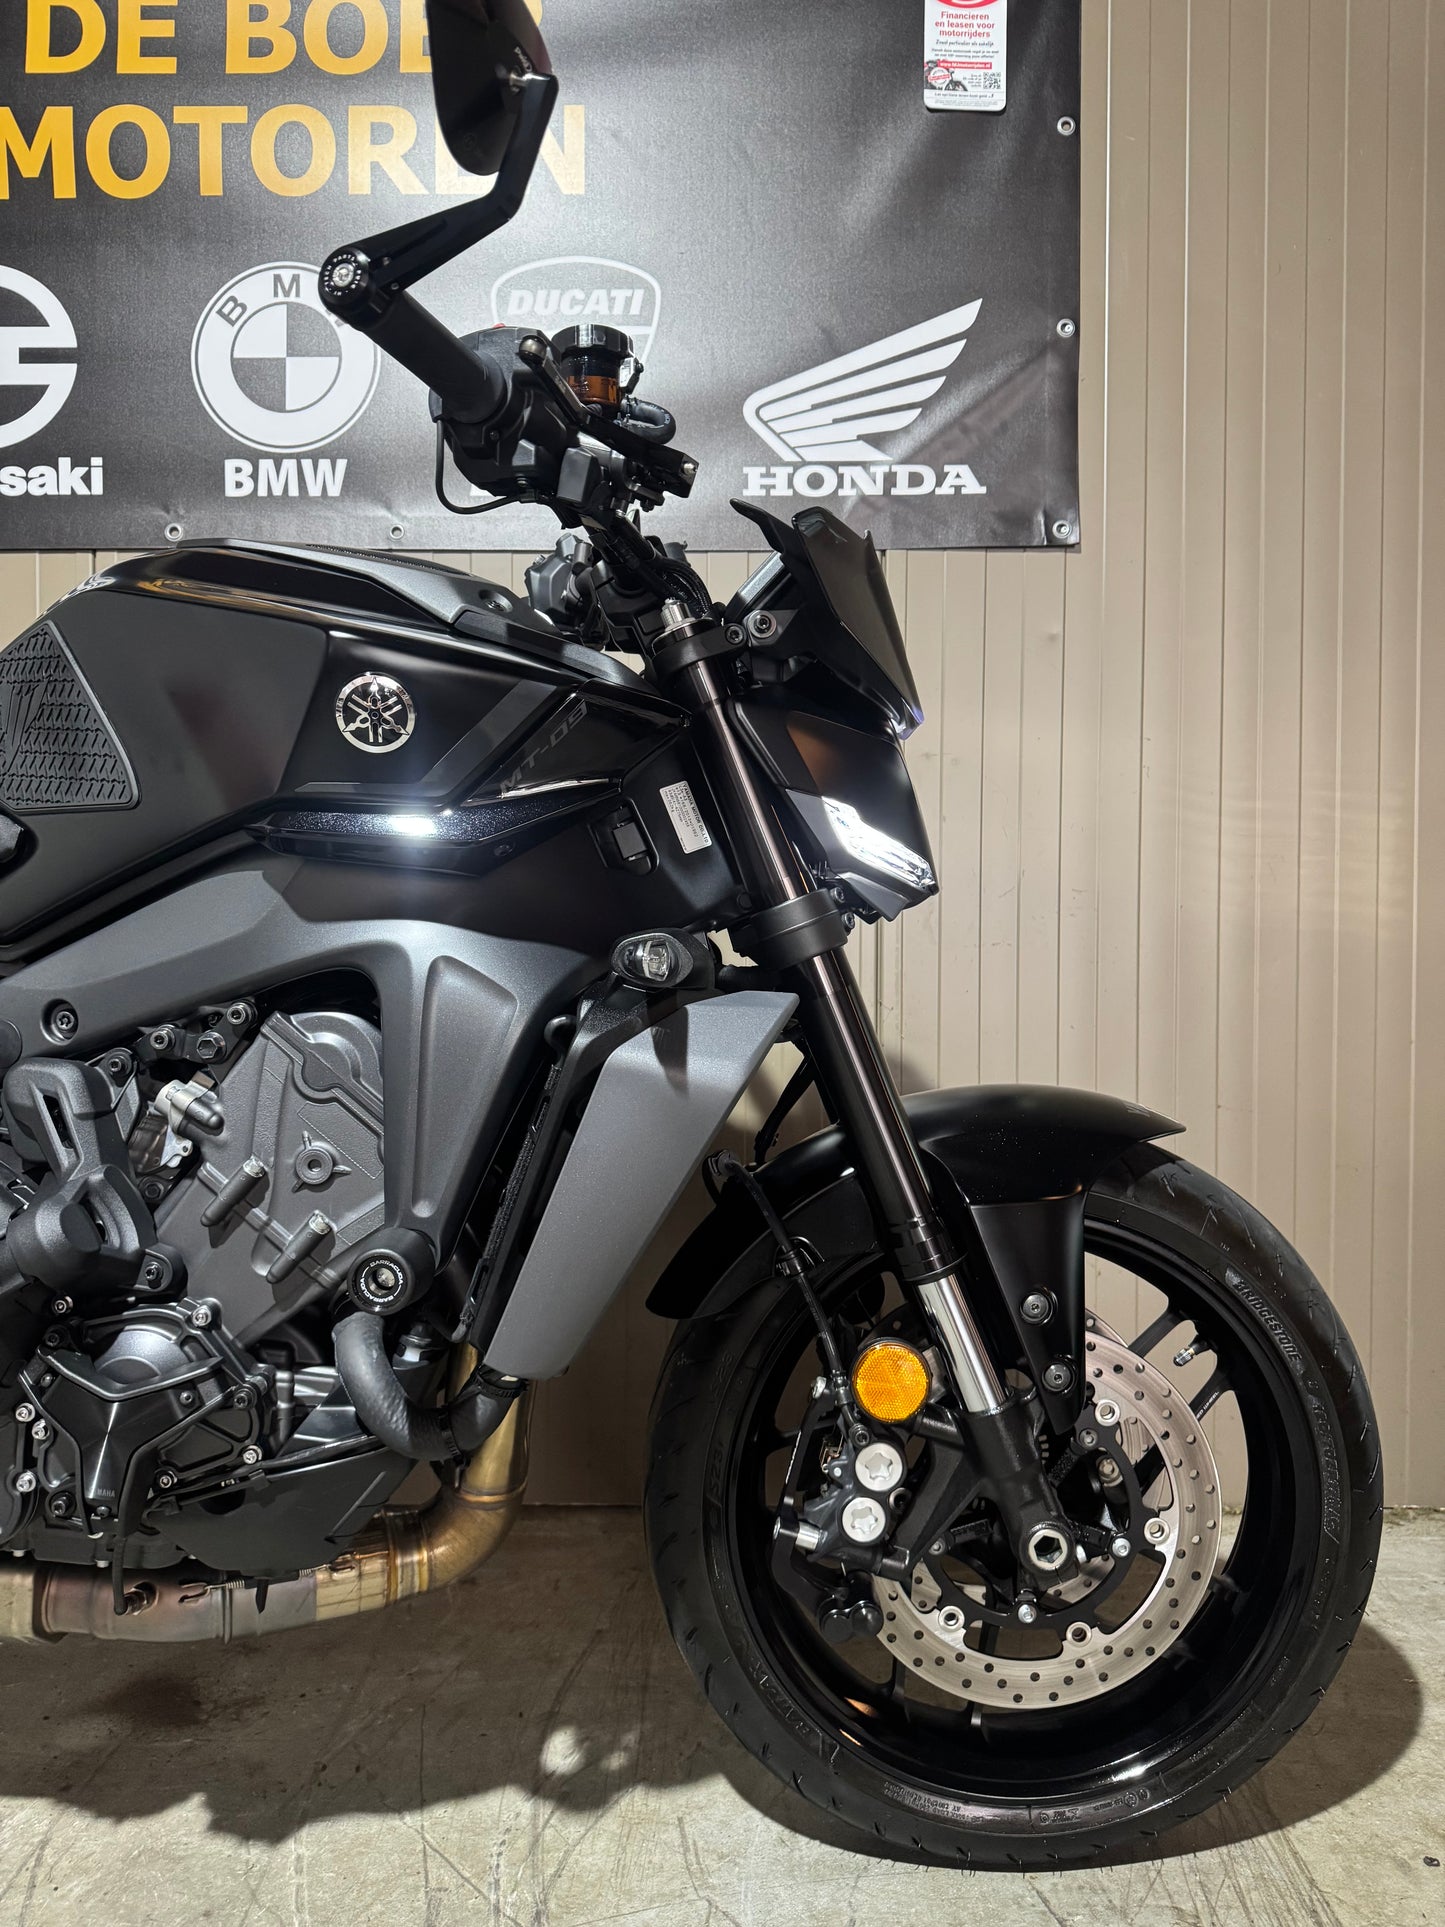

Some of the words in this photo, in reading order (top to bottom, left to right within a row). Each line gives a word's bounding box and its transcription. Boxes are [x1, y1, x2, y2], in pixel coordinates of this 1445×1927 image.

[941, 11, 990, 20] Financieren
[947, 20, 974, 28] leasen
[25, 0, 177, 74] DE
[226, 0, 543, 75] BOE
[939, 30, 991, 39] motorrijders
[506, 288, 645, 316] DUCATI
[224, 458, 348, 498] BMW
[742, 464, 987, 497] HONDA
[501, 699, 588, 794] MT-09
[682, 784, 694, 806] YAMAHA
[691, 806, 702, 824] MOTOR
[369, 1260, 404, 1285] BARRACUDA
[360, 1277, 395, 1303] BARRACUDA
[1233, 1277, 1303, 1363] BRIDGESTONE
